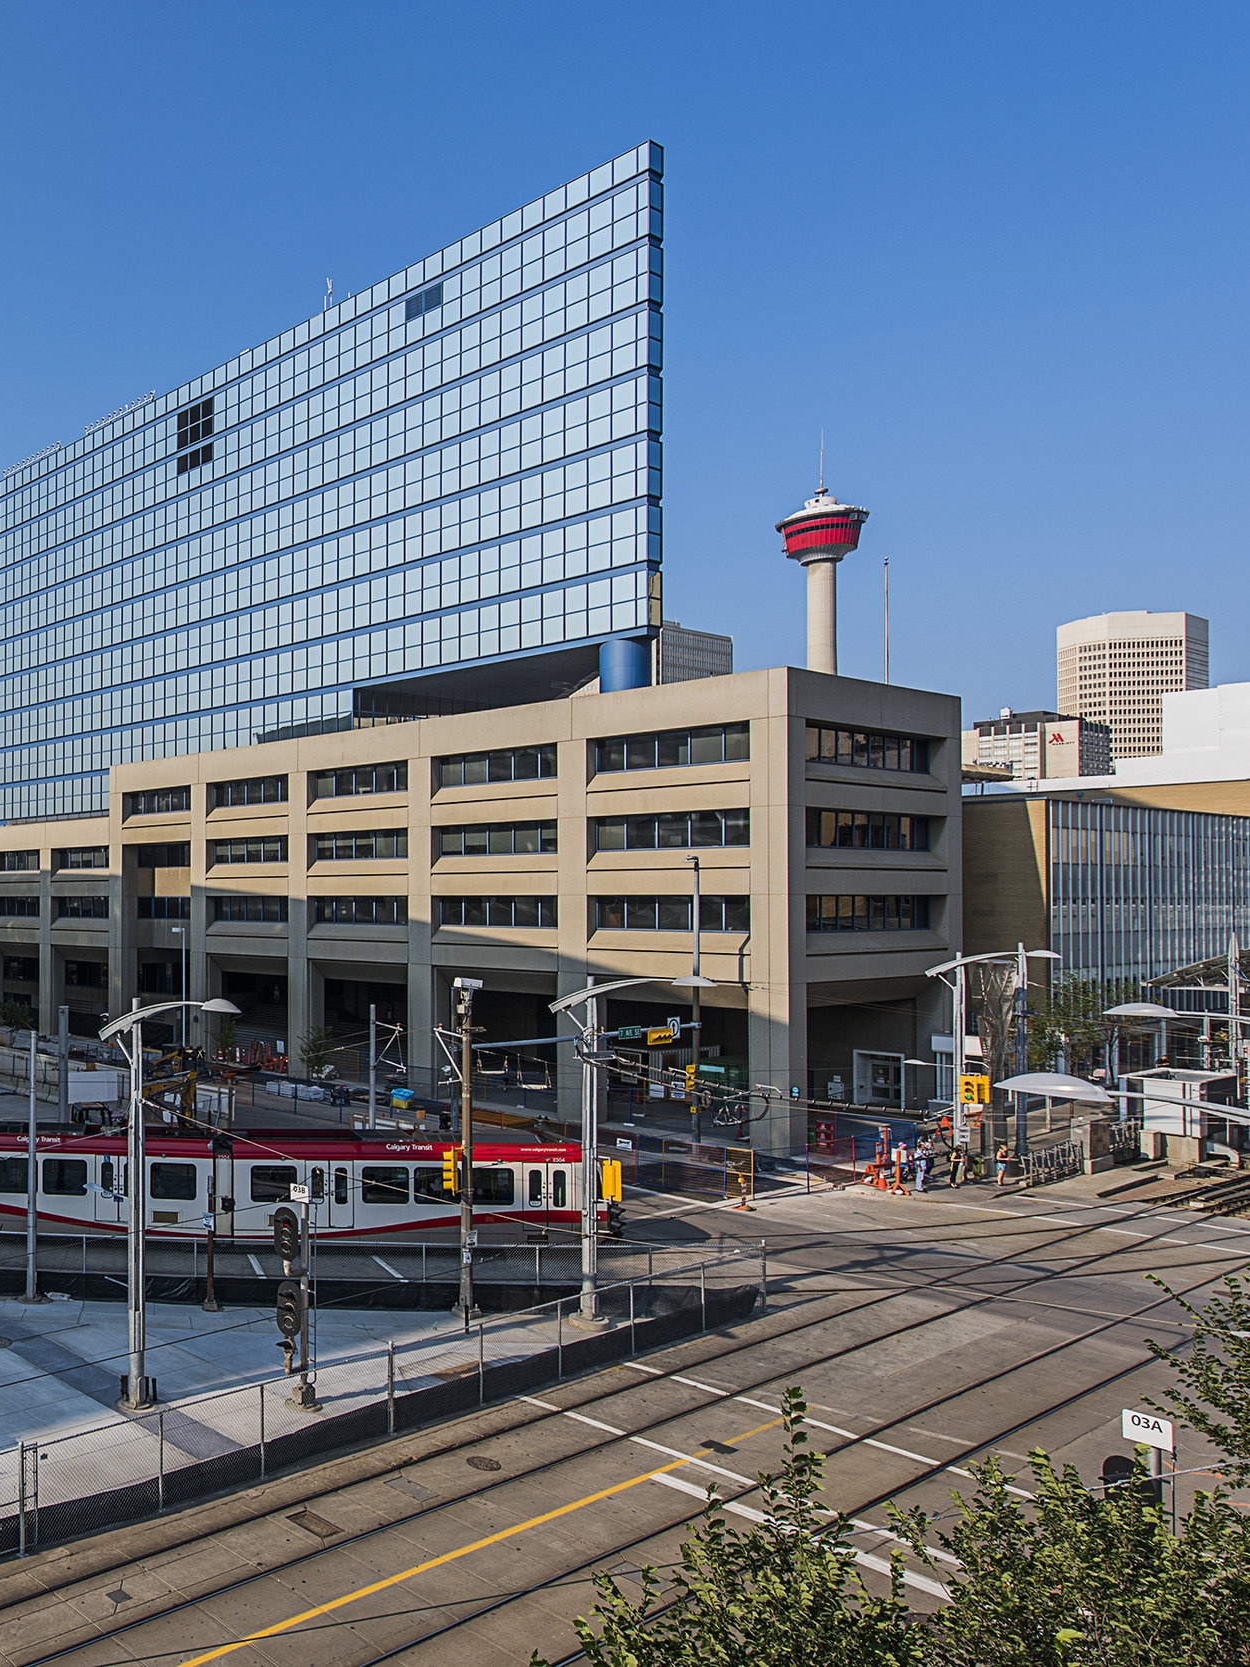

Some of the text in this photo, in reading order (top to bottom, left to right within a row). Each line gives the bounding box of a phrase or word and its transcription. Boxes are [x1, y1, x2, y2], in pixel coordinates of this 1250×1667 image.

[625, 1029, 633, 1037] AVE
[634, 1028, 640, 1036] SE
[16, 1135, 40, 1144] Calgy
[386, 1143, 410, 1152] Calgary
[293, 1186, 306, 1194] 03B
[1131, 1414, 1163, 1433] 03A
